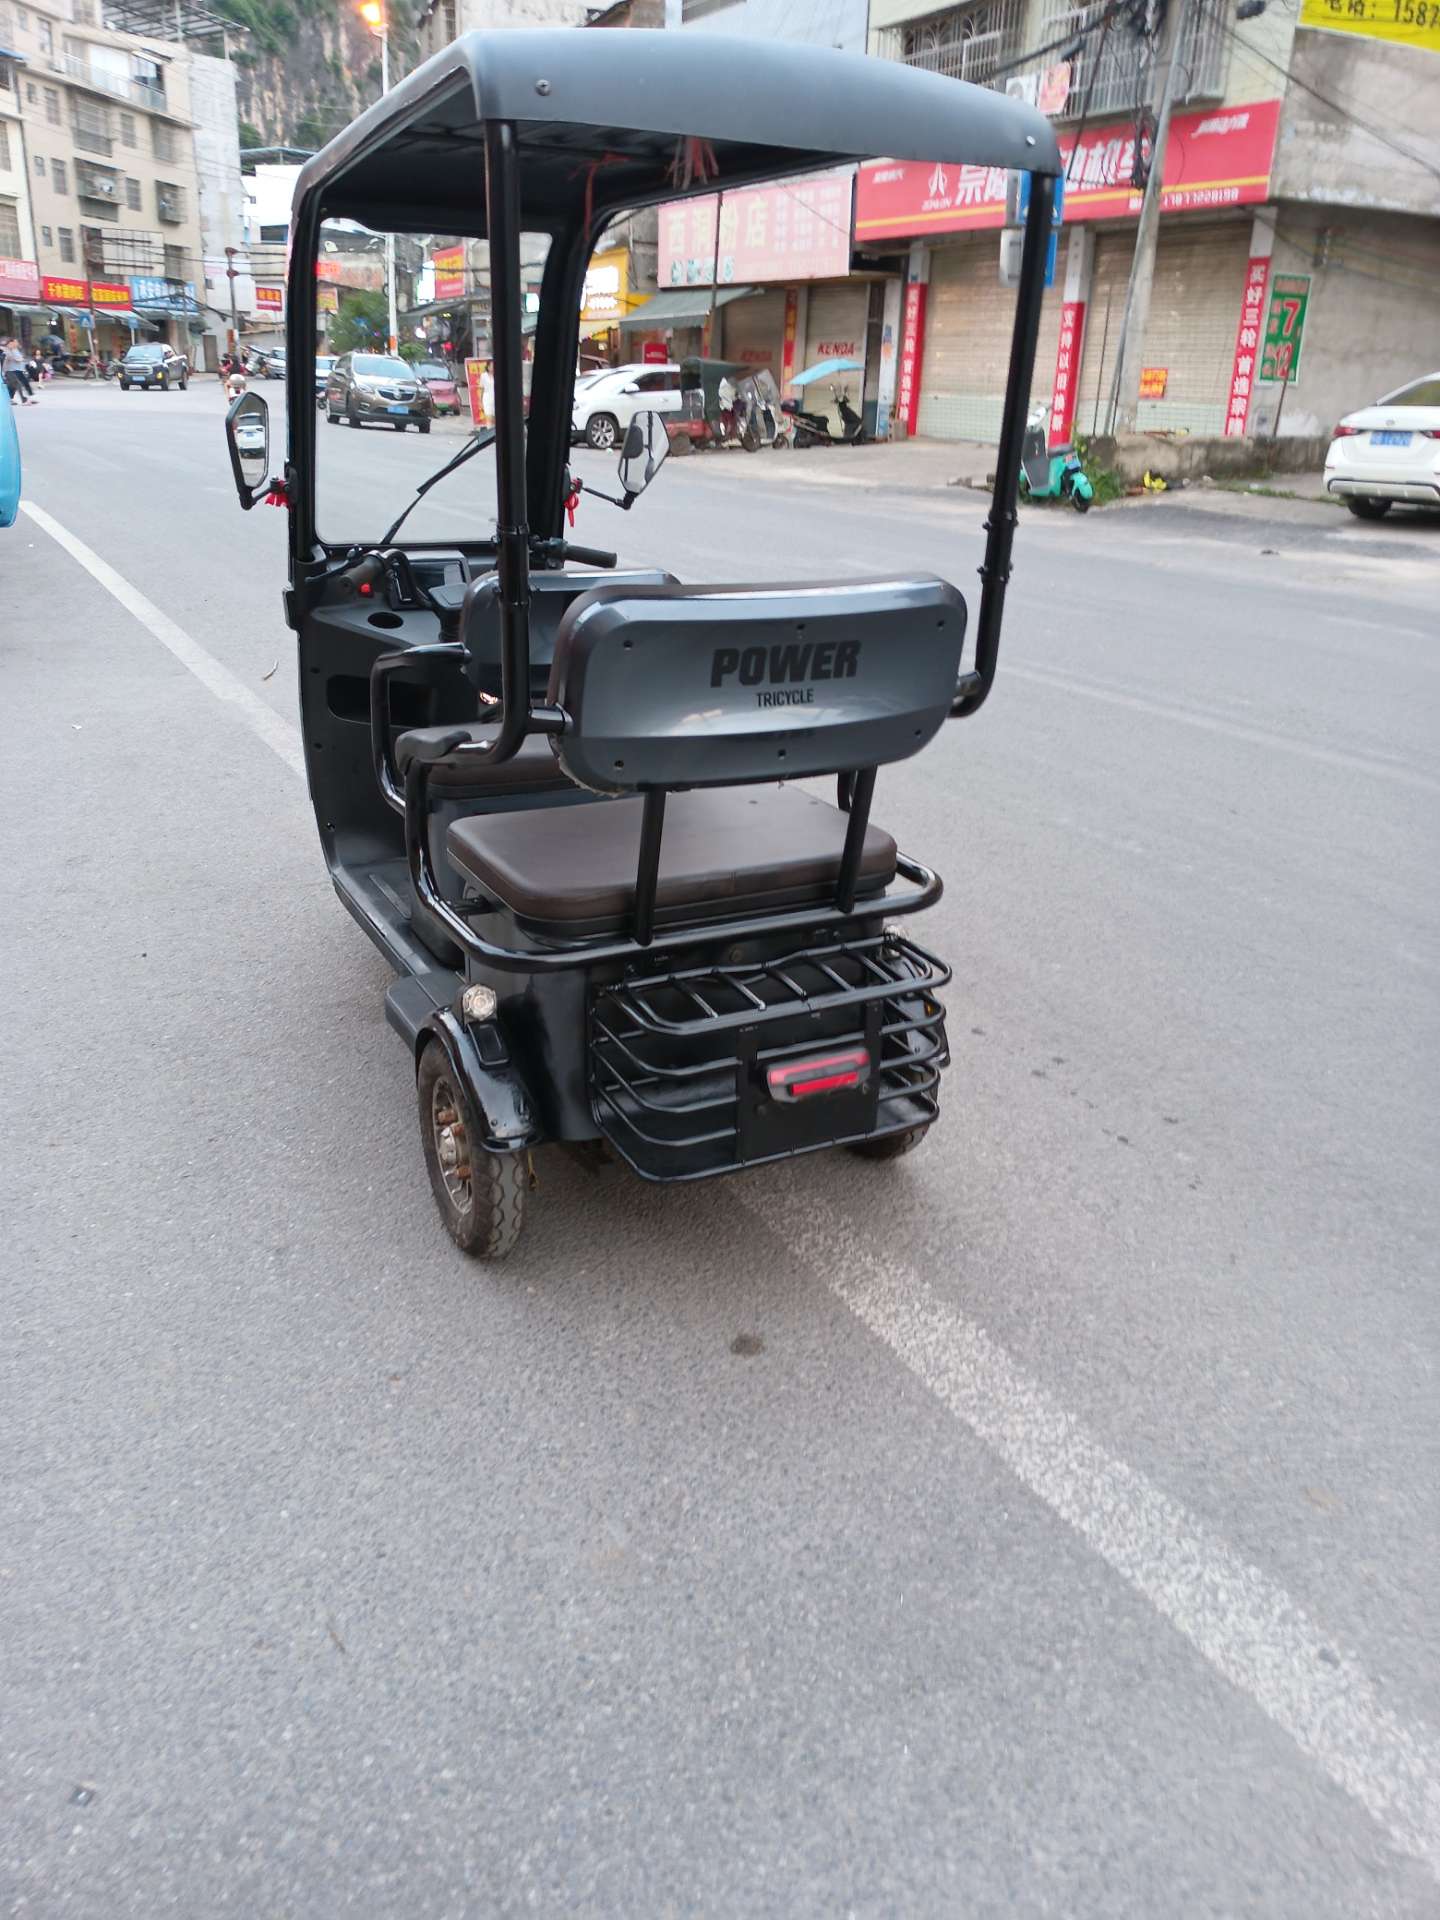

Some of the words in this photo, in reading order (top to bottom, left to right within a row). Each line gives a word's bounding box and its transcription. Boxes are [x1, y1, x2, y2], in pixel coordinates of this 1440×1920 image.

[1282, 299, 1301, 337] 7
[817, 342, 856, 356] KENDA
[709, 639, 862, 688] POWER
[755, 688, 815, 708] TRICYCLE
